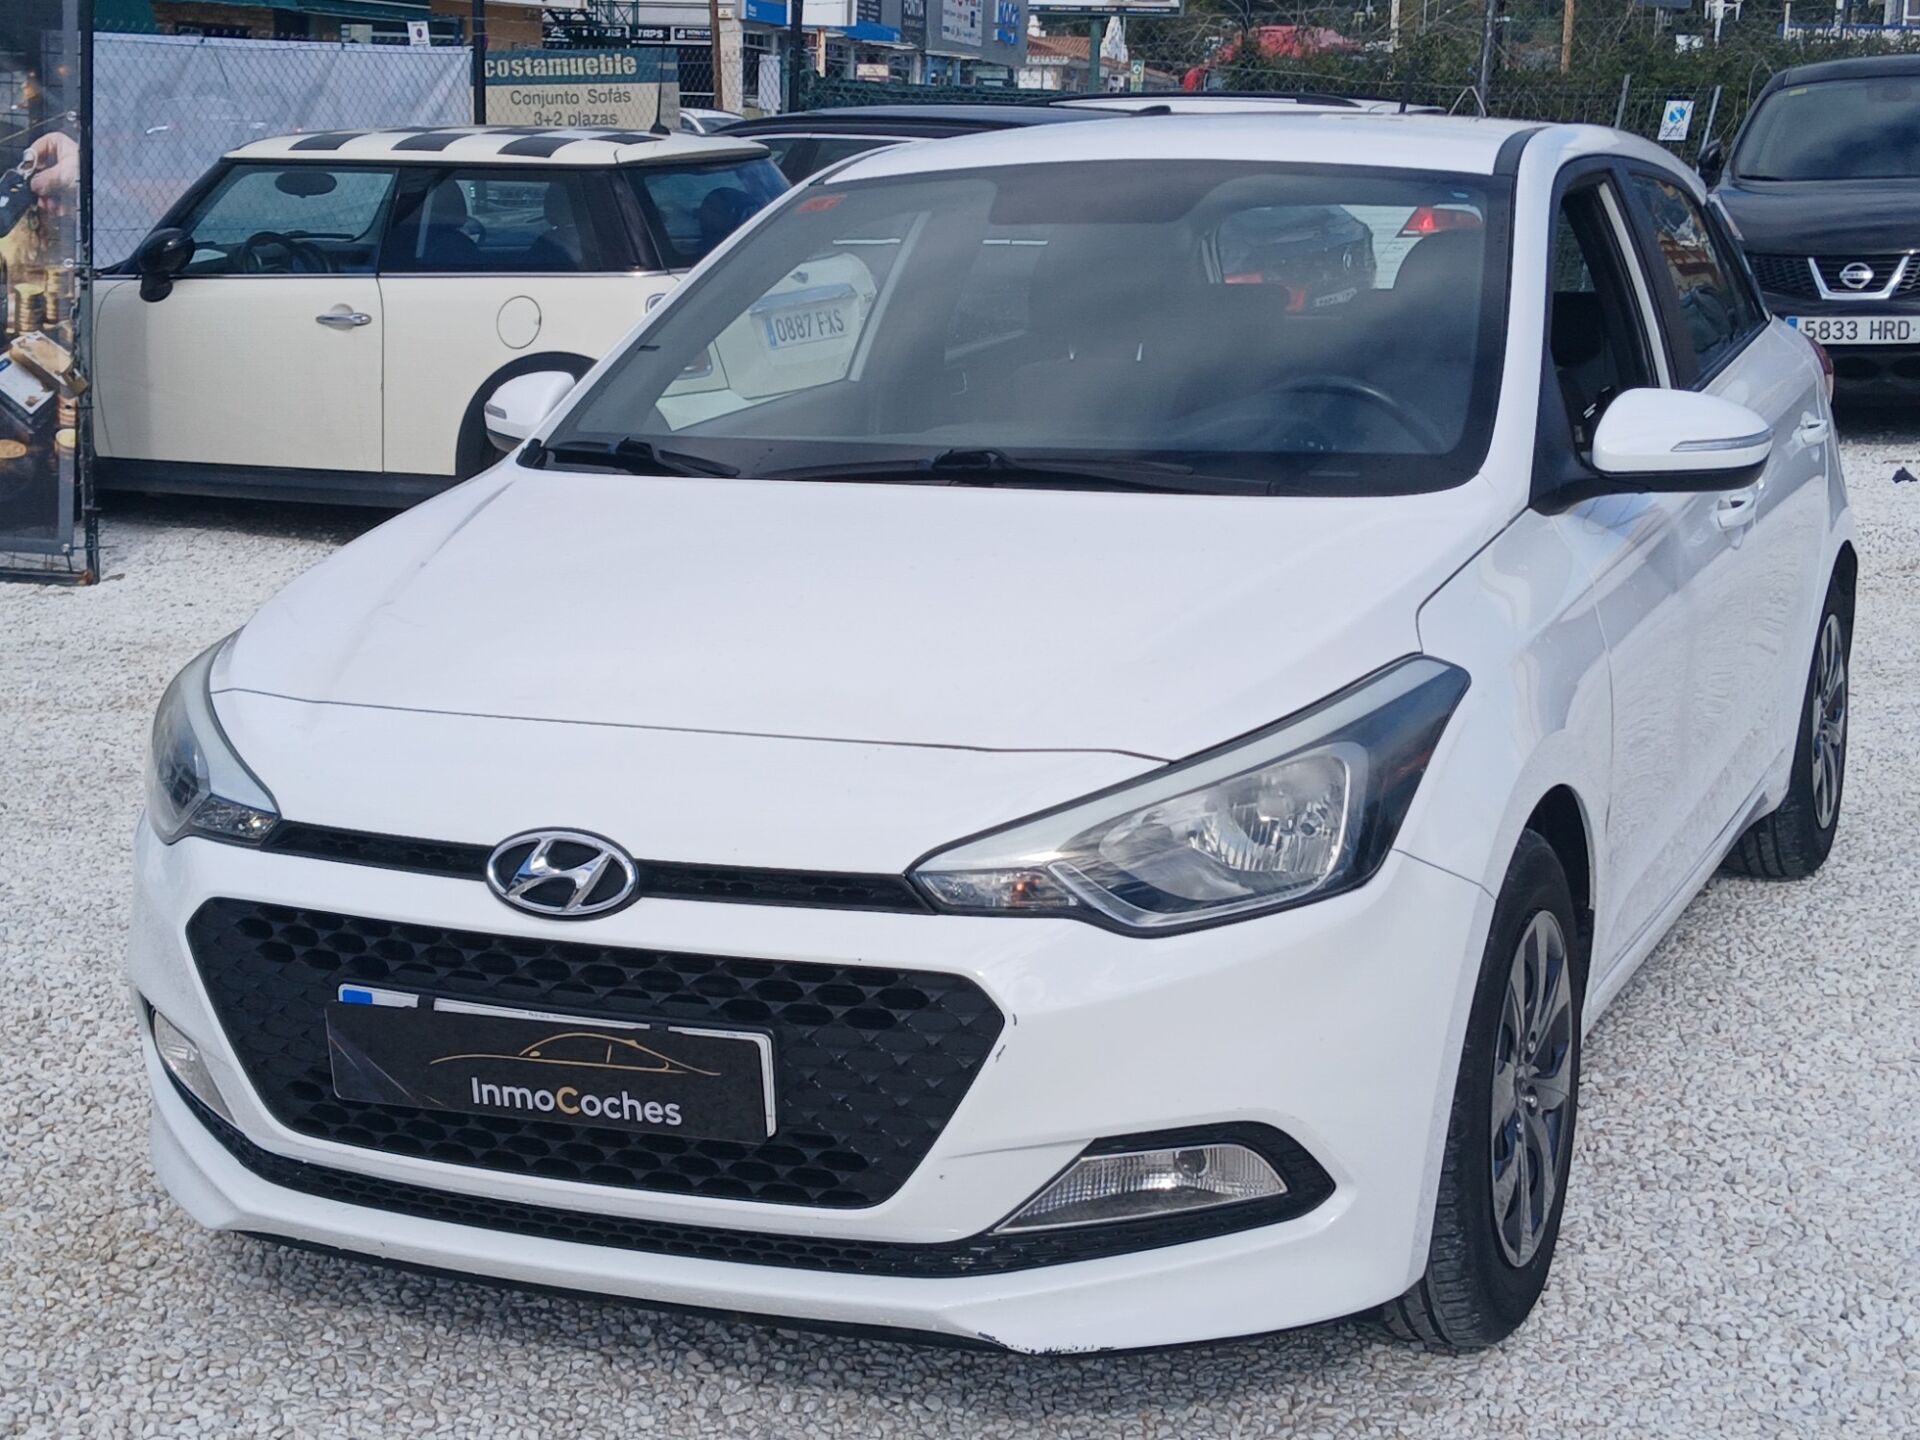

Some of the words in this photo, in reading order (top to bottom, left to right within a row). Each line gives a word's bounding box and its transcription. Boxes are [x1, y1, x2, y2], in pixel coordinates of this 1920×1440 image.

[484, 53, 638, 78] costamueble
[510, 90, 580, 108] Conjunto
[587, 88, 632, 104] Sofás
[534, 111, 563, 127] 3+2
[567, 111, 618, 127] plazas
[775, 313, 813, 342] 0887
[815, 308, 845, 336] FXS
[1805, 320, 1858, 341] 5833
[1869, 320, 1911, 341] HRD
[471, 1076, 683, 1126] InmoCoches
